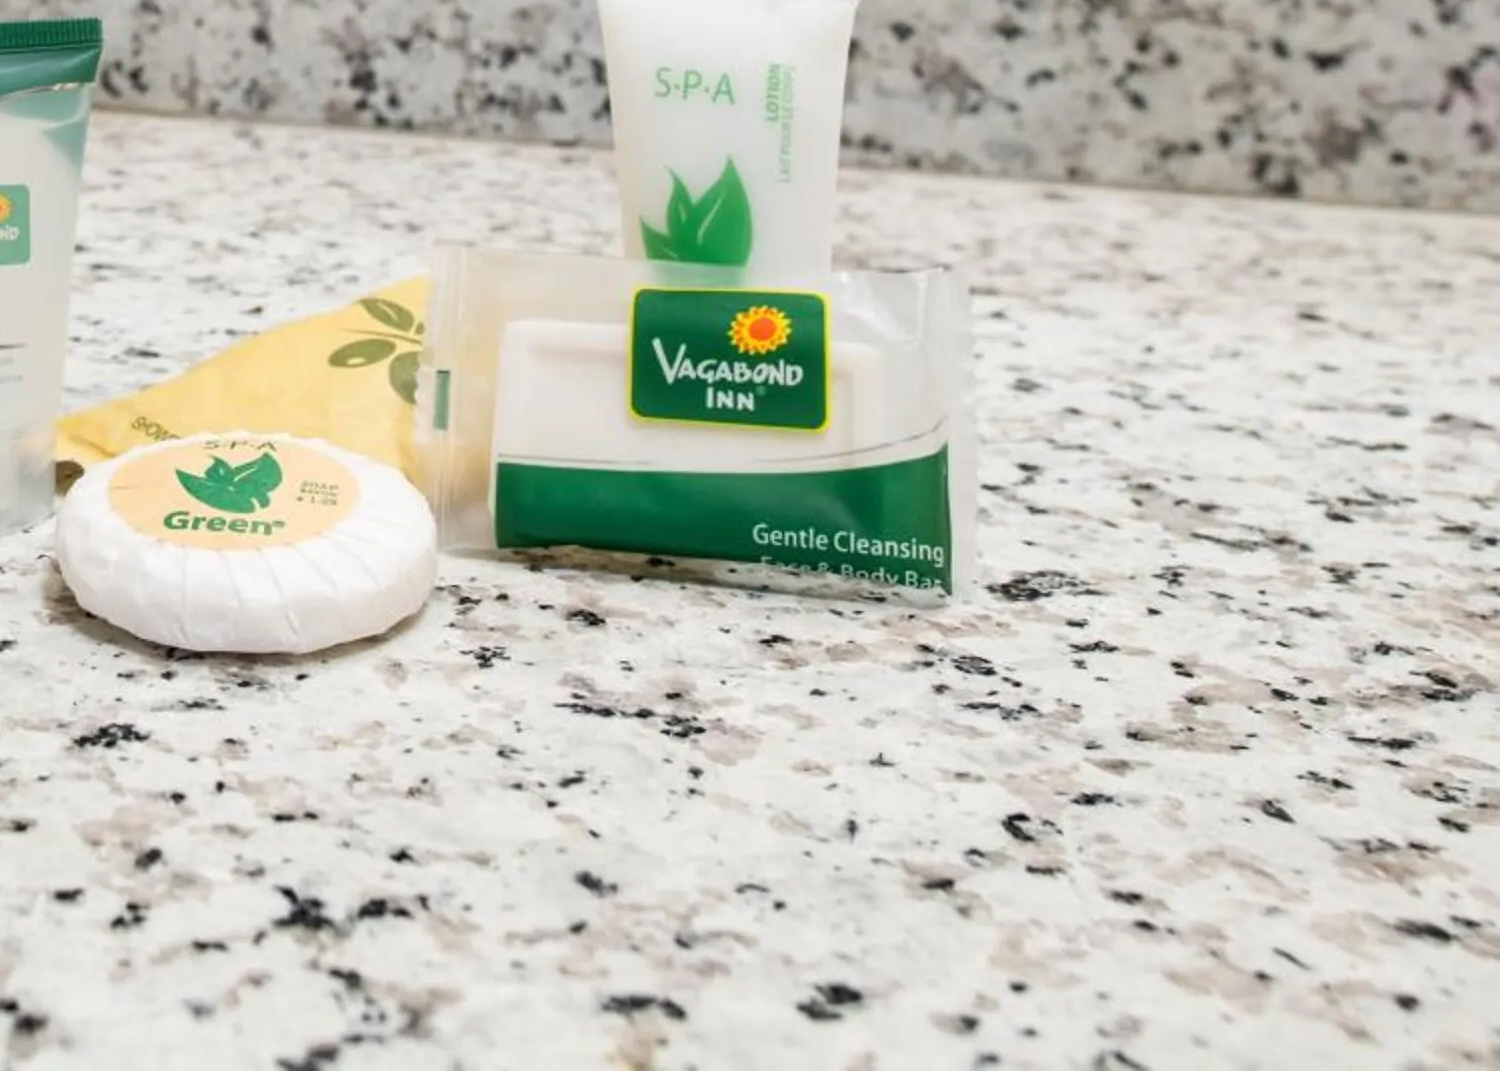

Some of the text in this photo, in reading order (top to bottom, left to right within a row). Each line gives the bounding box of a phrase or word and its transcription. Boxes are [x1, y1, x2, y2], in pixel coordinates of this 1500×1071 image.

[764, 62, 781, 123] LOTION
[651, 336, 805, 387] VAGABOND
[130, 415, 181, 442] SHOW
[752, 523, 945, 568] Gentle Cleansing
